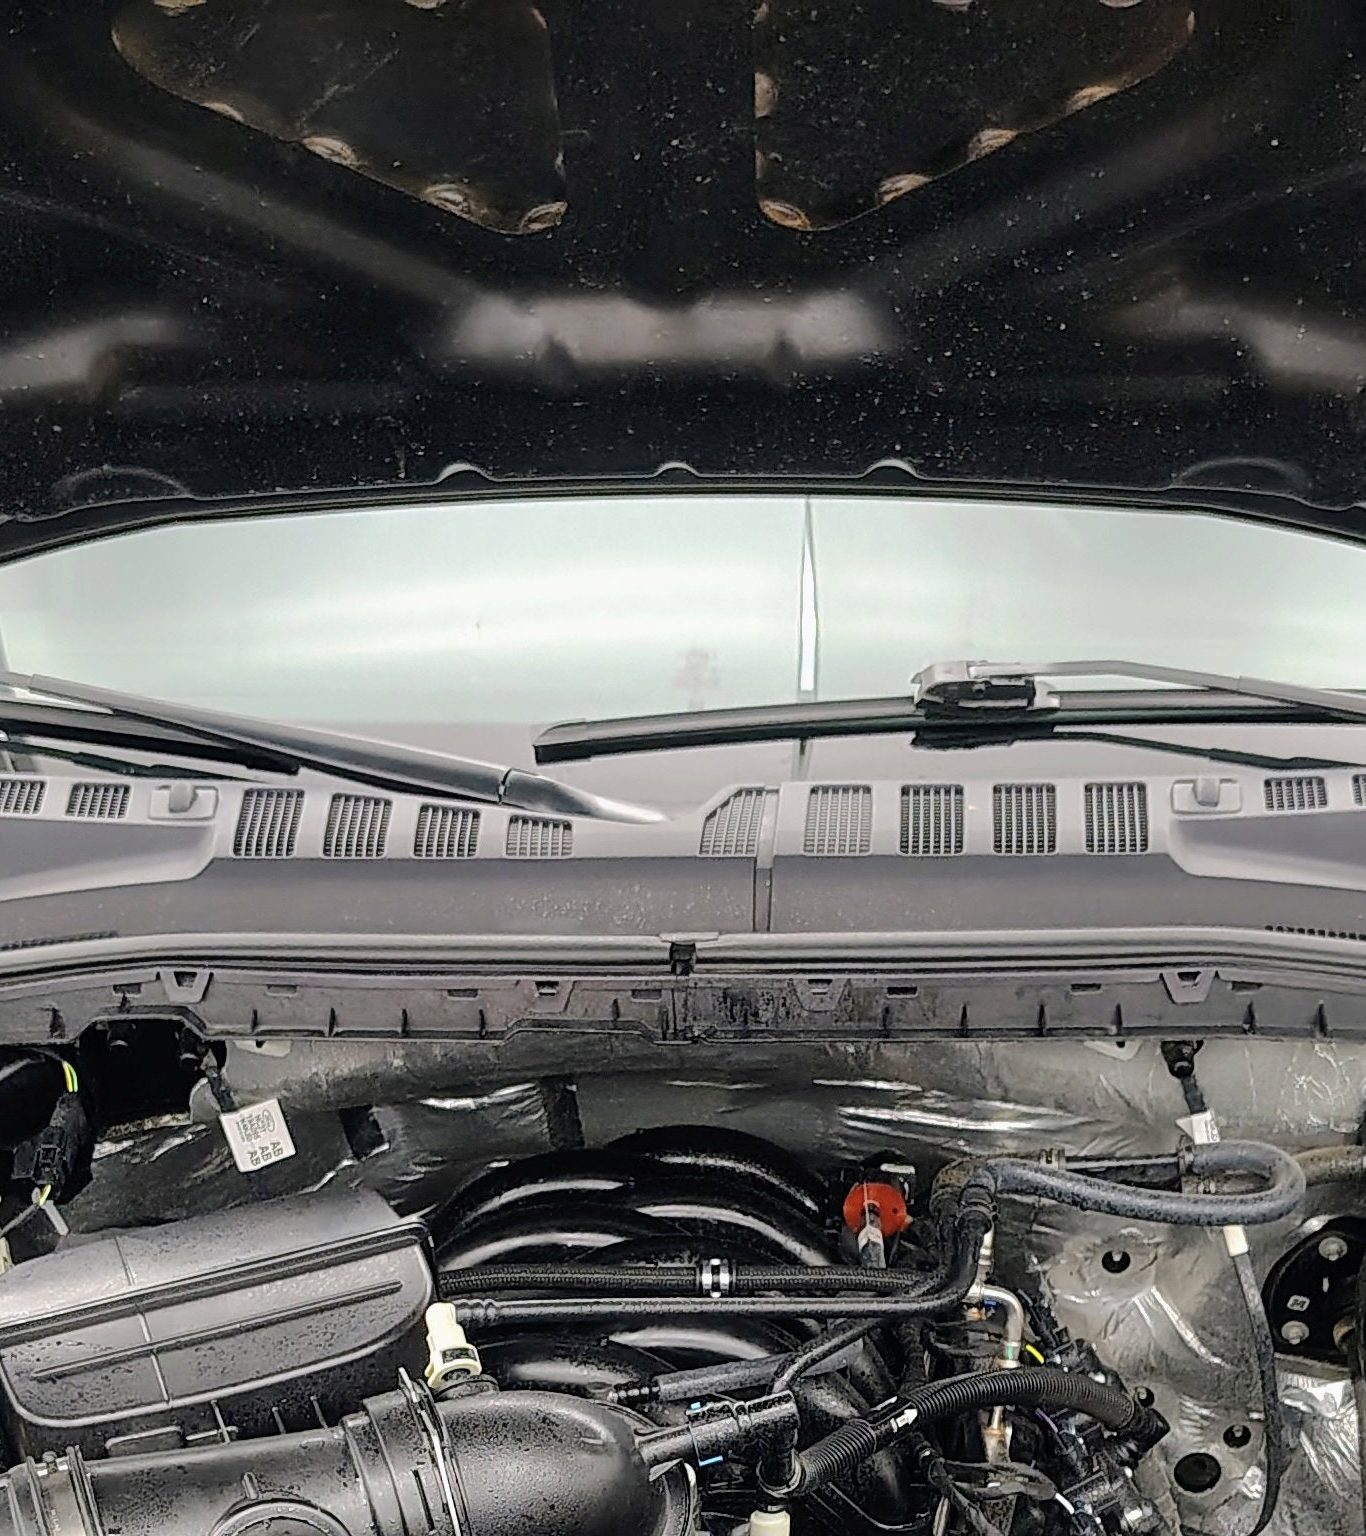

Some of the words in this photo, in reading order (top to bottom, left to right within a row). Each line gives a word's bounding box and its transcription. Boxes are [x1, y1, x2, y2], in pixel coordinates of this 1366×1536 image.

[259, 1146, 272, 1162] AB
[270, 1141, 284, 1157] AB
[247, 1150, 261, 1166] AB
